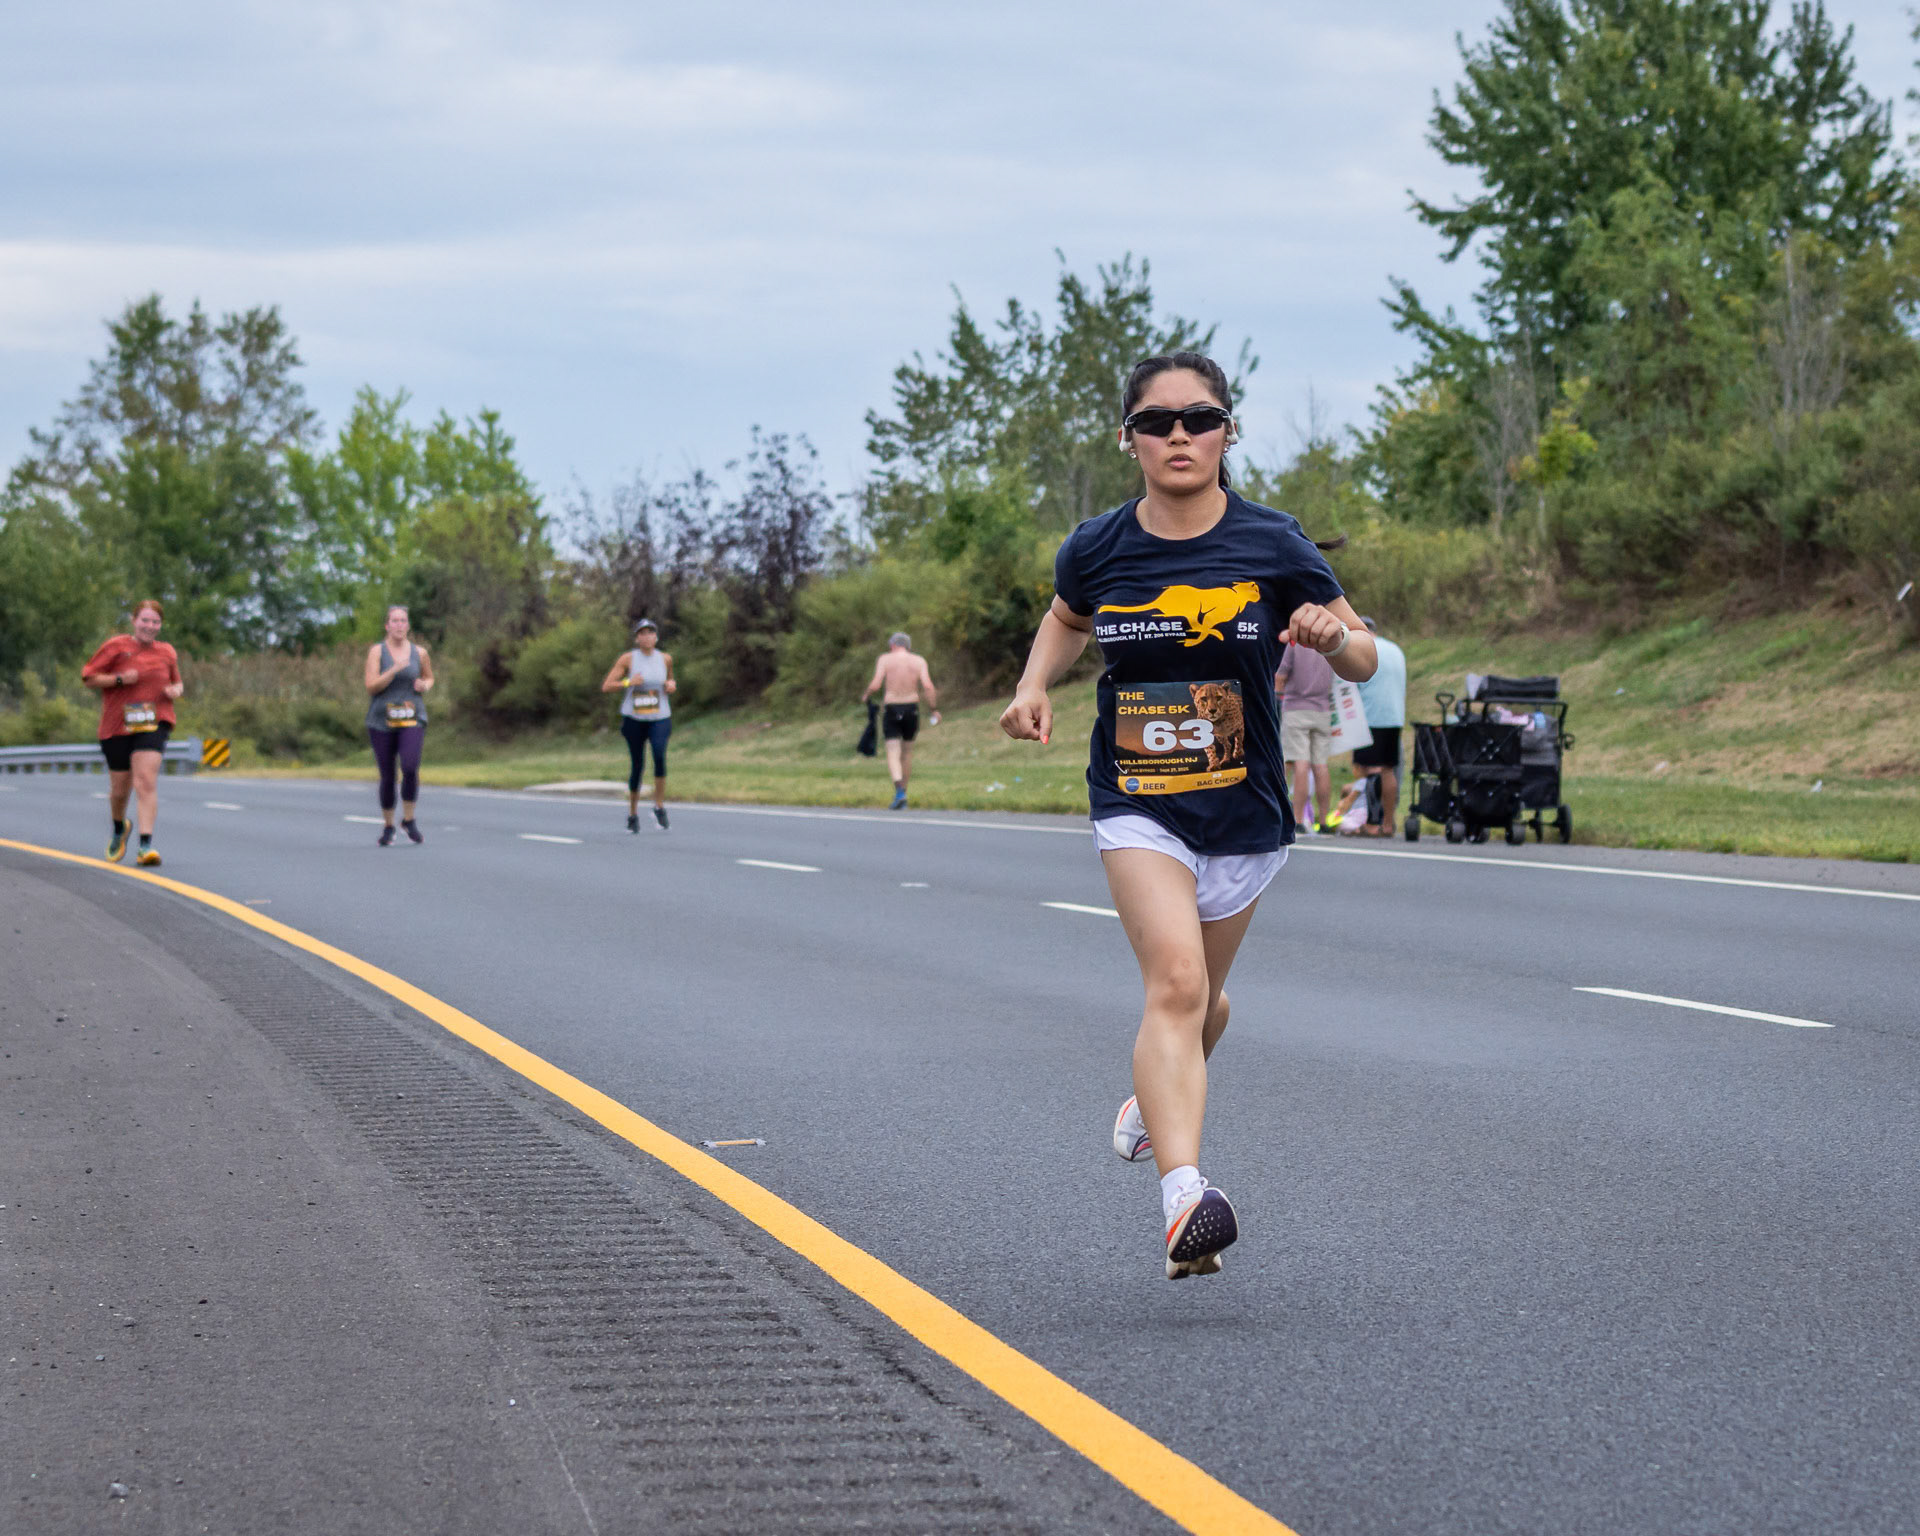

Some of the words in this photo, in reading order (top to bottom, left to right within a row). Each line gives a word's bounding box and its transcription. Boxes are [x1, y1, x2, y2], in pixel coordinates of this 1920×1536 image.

[1096, 625, 1118, 636] THE
[1119, 621, 1183, 633] CHASE
[1237, 621, 1259, 632] 5K
[1118, 691, 1144, 700] THE
[1118, 705, 1167, 715] CHASE
[1168, 704, 1190, 714] 5K
[1143, 719, 1215, 751] 63
[1214, 776, 1240, 785] CHECK
[1142, 782, 1166, 791] BEER
